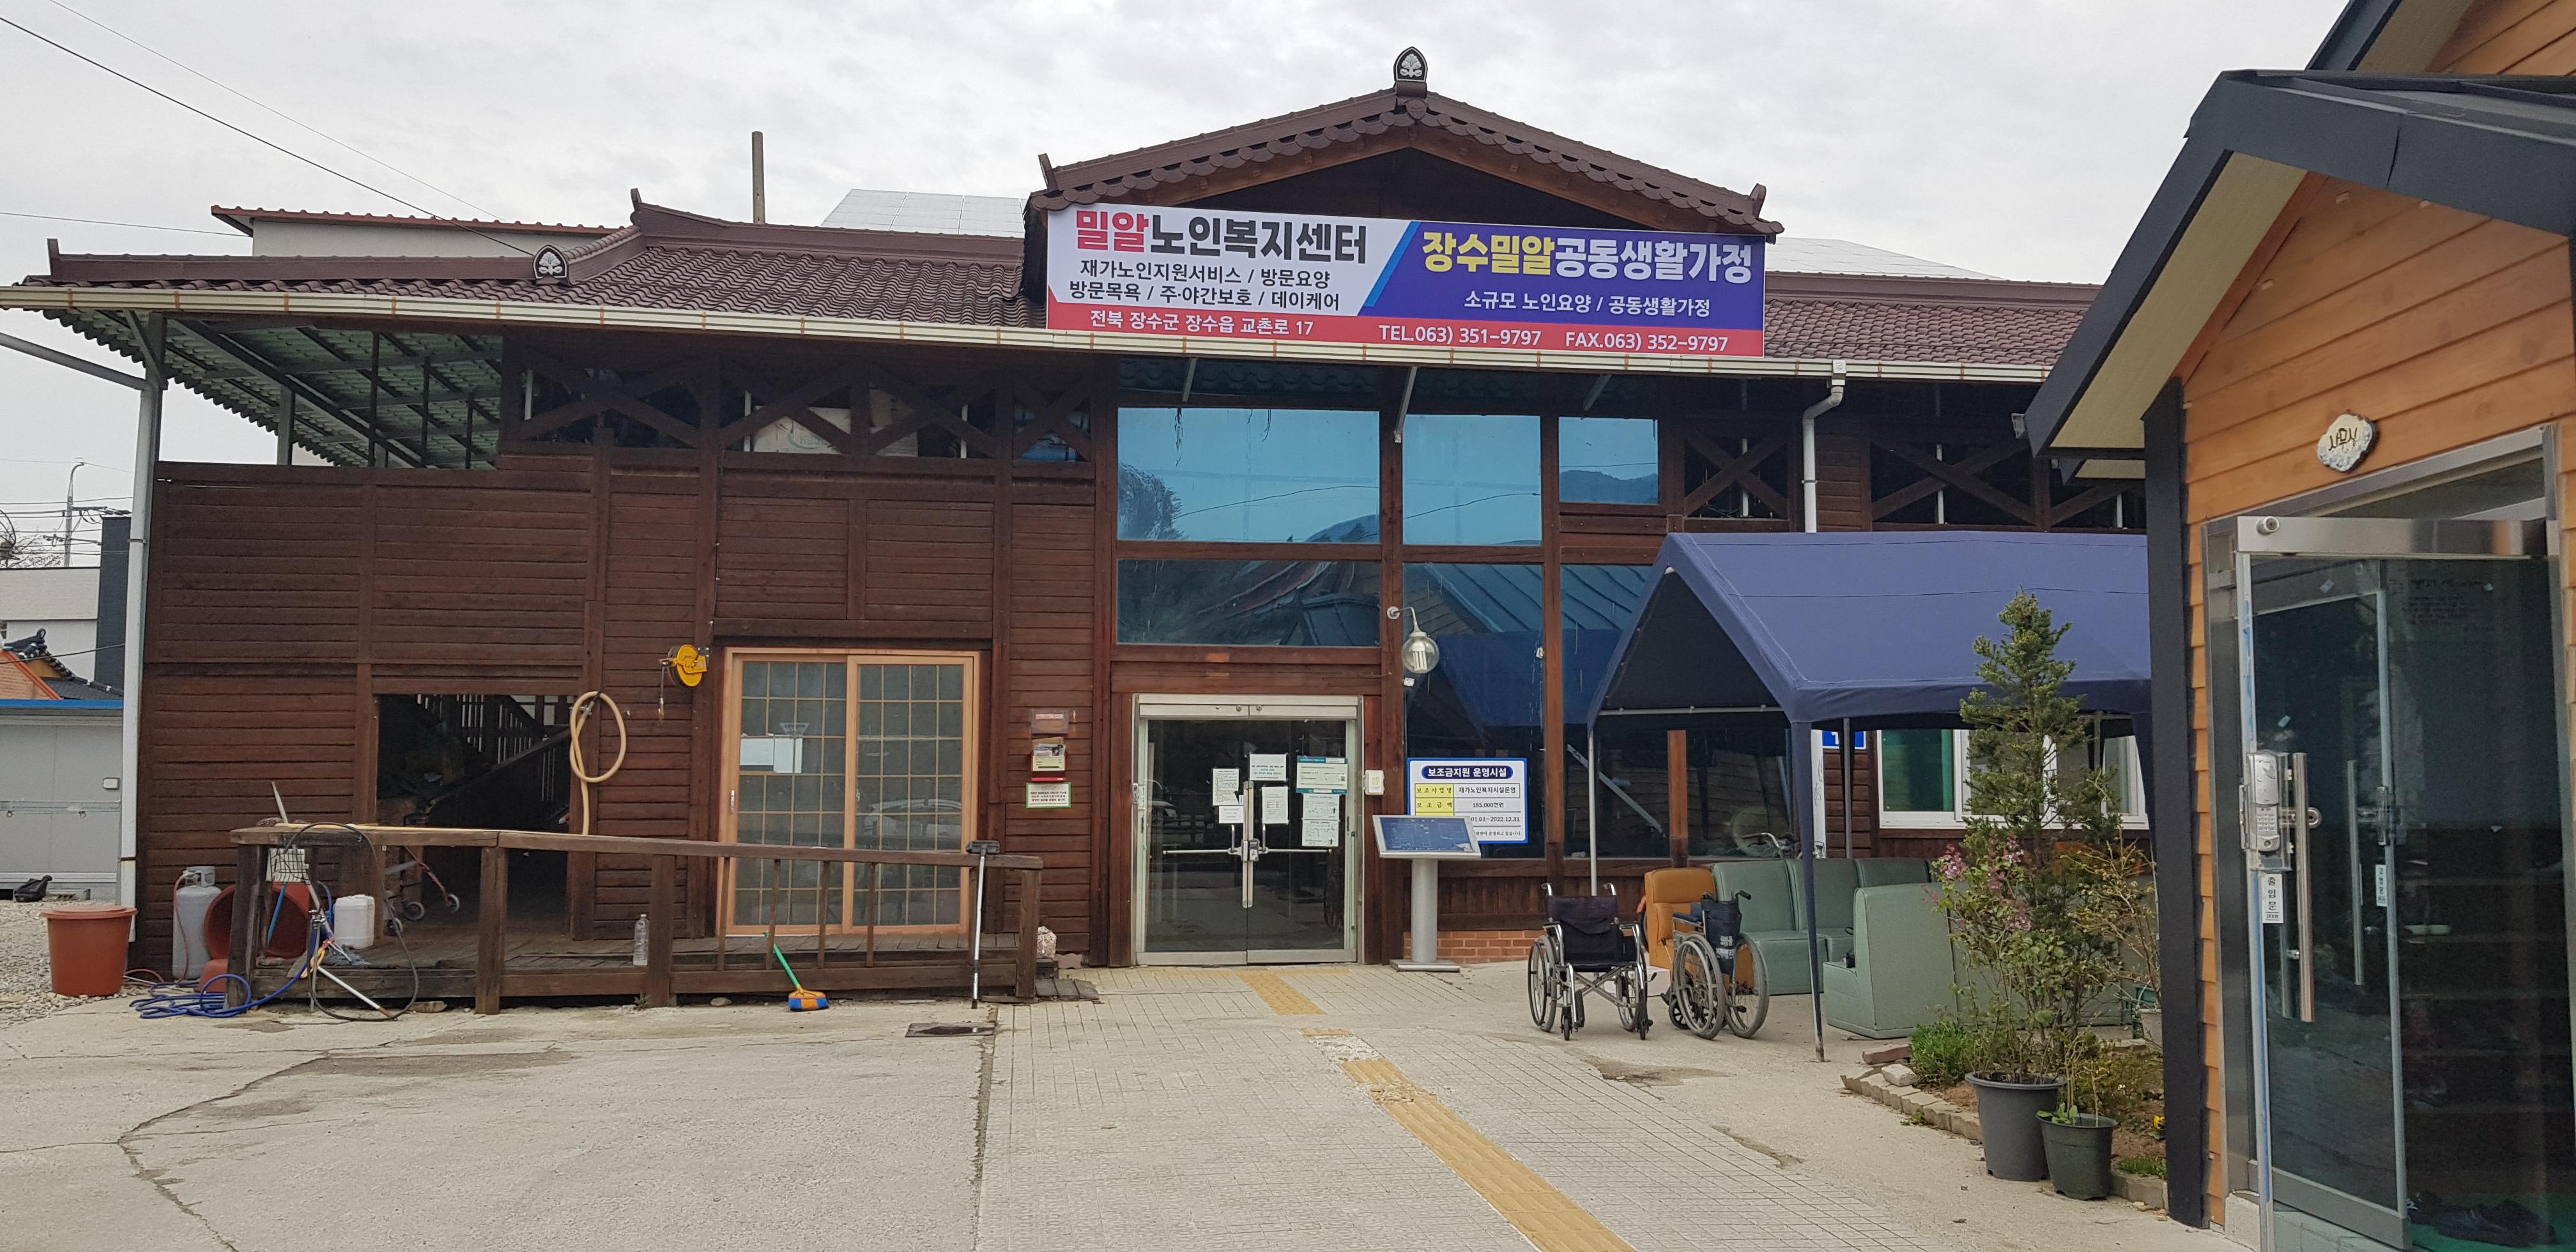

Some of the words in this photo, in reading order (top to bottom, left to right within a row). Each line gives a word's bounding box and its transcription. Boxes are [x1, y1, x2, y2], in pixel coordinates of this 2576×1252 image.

[1076, 210, 1366, 264] 밀알노인복지센터
[1422, 231, 1752, 284] 장수밀알공동생활가정
[1080, 259, 1242, 284] 재가노인지원서비스
[1248, 269, 1255, 284] /
[1261, 269, 1330, 289] 방문요양
[1070, 281, 1141, 302] 방문목욕
[1147, 286, 1154, 300] /
[1160, 286, 1252, 306] 주·야간보호
[1258, 291, 1265, 306] /
[1271, 291, 1339, 311] 데이케어
[1464, 291, 1516, 310] 소규모
[1522, 293, 1591, 313] 노인요양
[1597, 296, 1602, 312] /
[1609, 296, 1710, 317] 공동생활가정
[1091, 310, 1123, 328] 전북
[1130, 312, 1179, 331] 장수군
[1186, 315, 1234, 333] 장수읍
[1240, 317, 1289, 335] 교촌로
[1296, 321, 1314, 335] 17
[1379, 324, 1453, 344] TEL.063)
[1459, 328, 1542, 346] 351-9797
[1565, 332, 1641, 351] FAX.063)
[1648, 334, 1728, 351] 352-9797
[1428, 767, 1470, 777] 보조금지원
[1473, 767, 1506, 777] 운영시설
